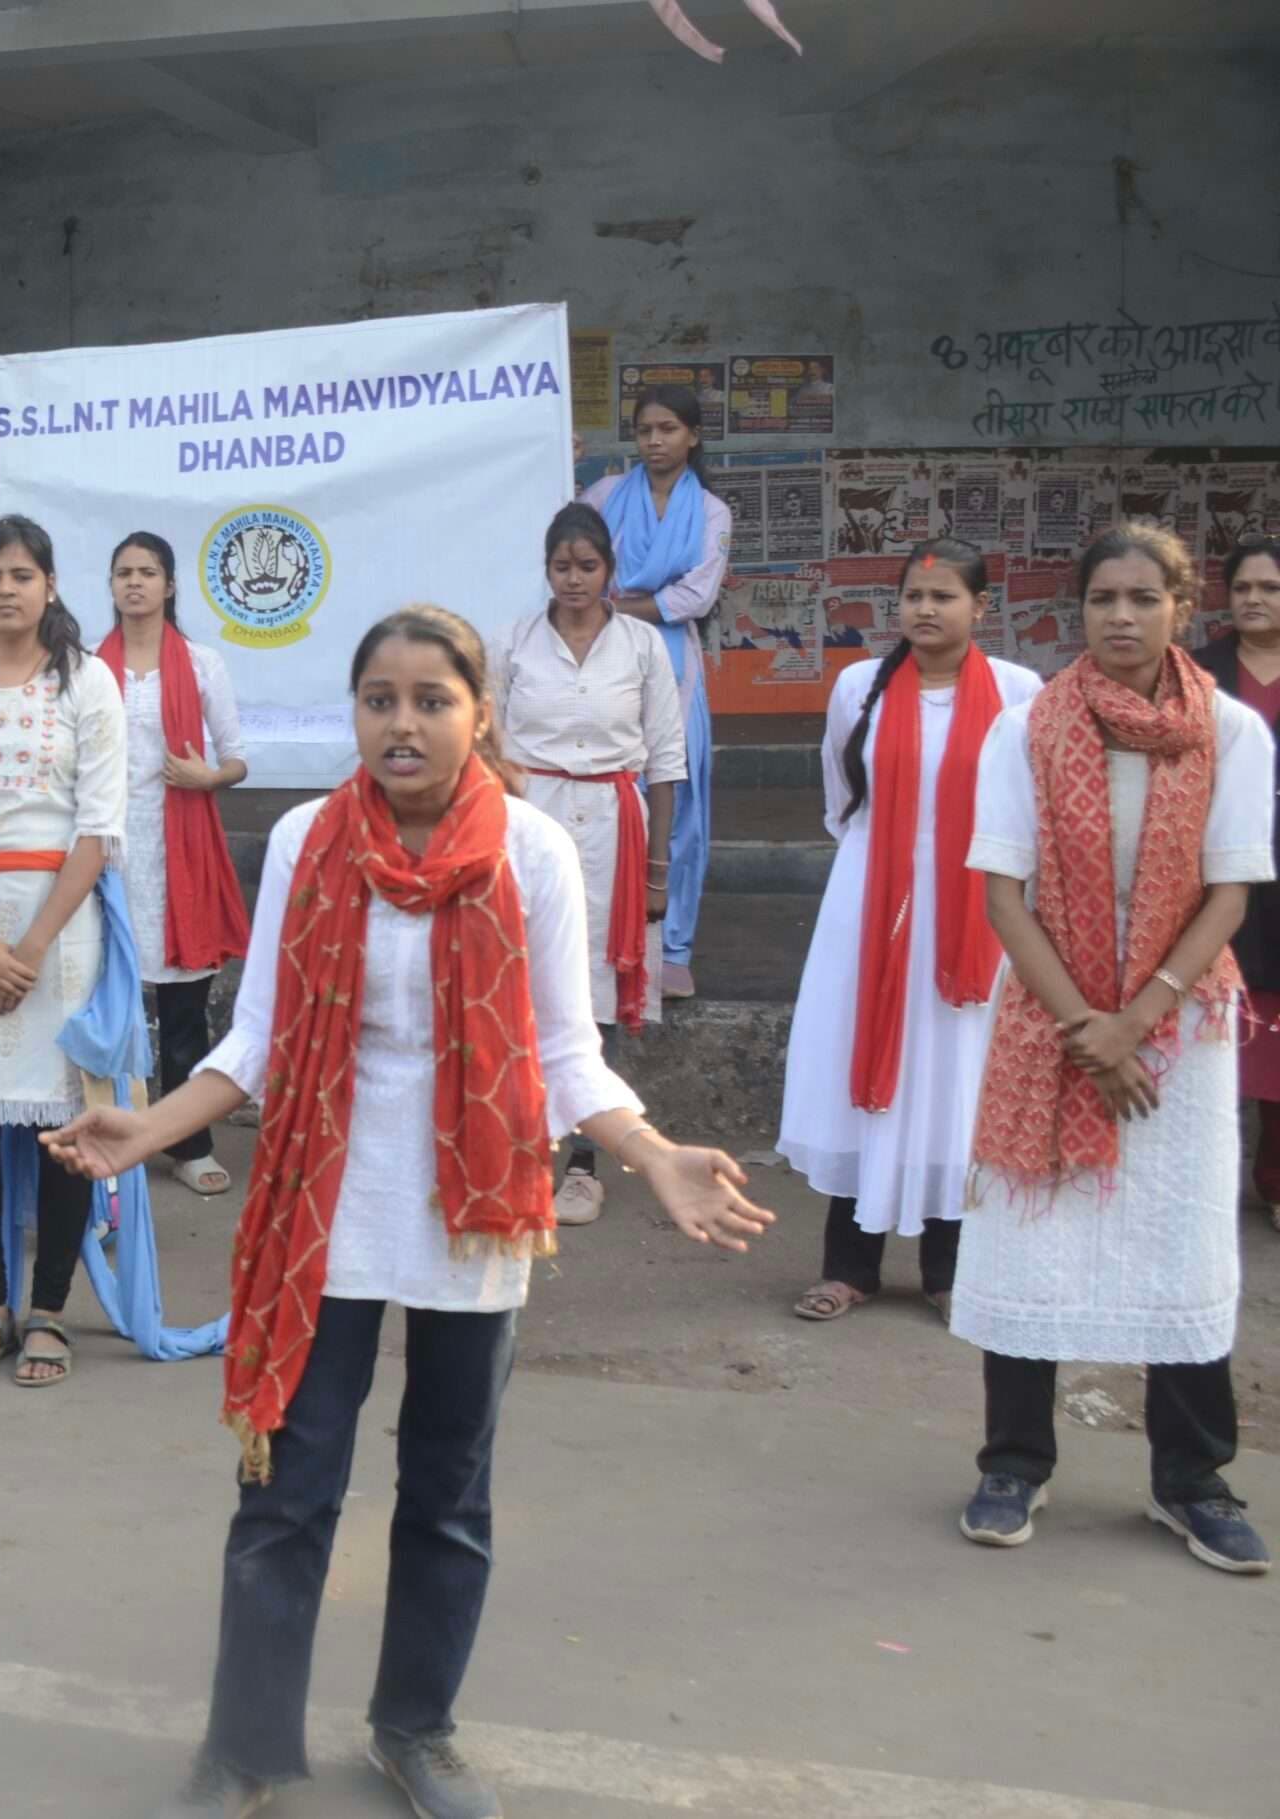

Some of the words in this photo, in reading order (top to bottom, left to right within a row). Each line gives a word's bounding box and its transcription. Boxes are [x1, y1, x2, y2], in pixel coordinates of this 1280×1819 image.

[1097, 307, 1151, 359] को
[129, 389, 253, 428] MAHILA
[263, 361, 561, 419] MAHAVIDYALAYA
[179, 431, 346, 473] DHANBAD
[221, 513, 261, 541] MAHILA
[262, 512, 324, 588] MAHAVIDYALAYA
[233, 622, 302, 639] DHANBAD
